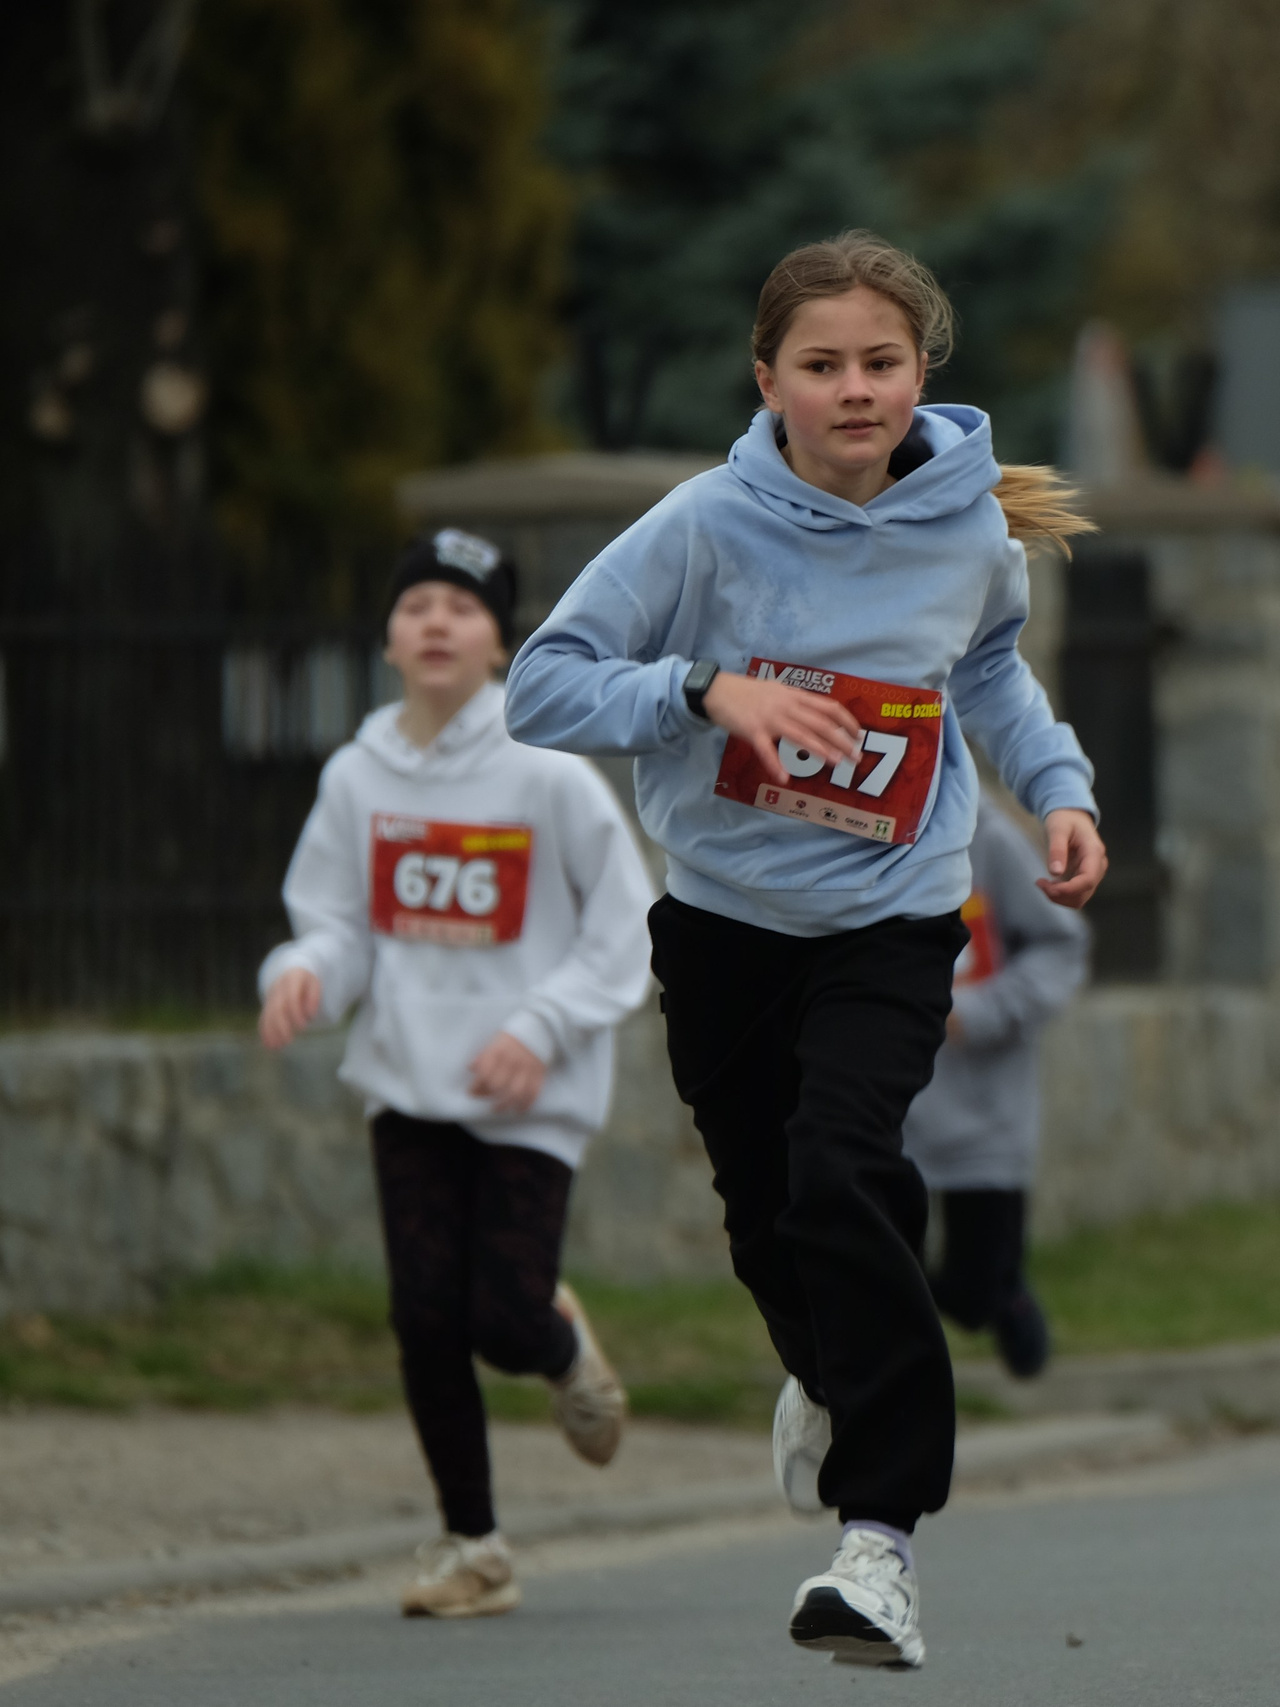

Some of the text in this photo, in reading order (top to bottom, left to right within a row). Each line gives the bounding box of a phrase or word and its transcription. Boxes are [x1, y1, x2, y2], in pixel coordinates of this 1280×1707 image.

[790, 668, 835, 688] BIEG
[881, 703, 912, 718] BIEG
[394, 851, 500, 916] 676
